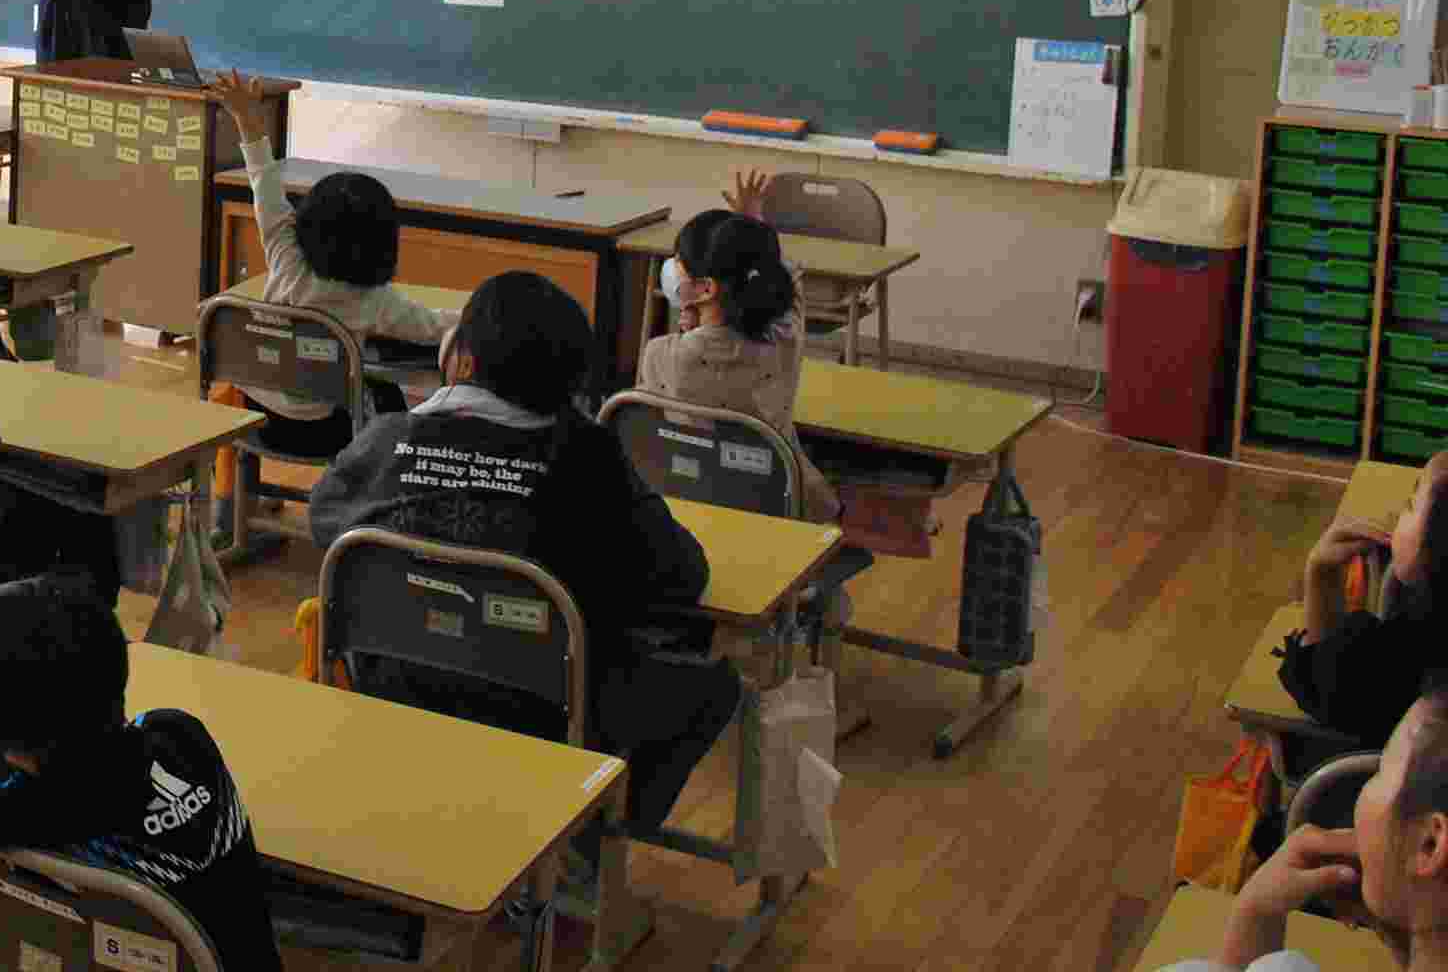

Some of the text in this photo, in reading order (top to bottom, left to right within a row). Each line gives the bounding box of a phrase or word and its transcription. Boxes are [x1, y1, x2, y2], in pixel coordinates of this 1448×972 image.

[393, 442, 414, 455] No
[416, 446, 472, 462] matter
[473, 452, 508, 466] how
[429, 461, 467, 476] may
[495, 468, 522, 481] the
[399, 472, 535, 497] stars are shining
[143, 785, 212, 836] adidas
